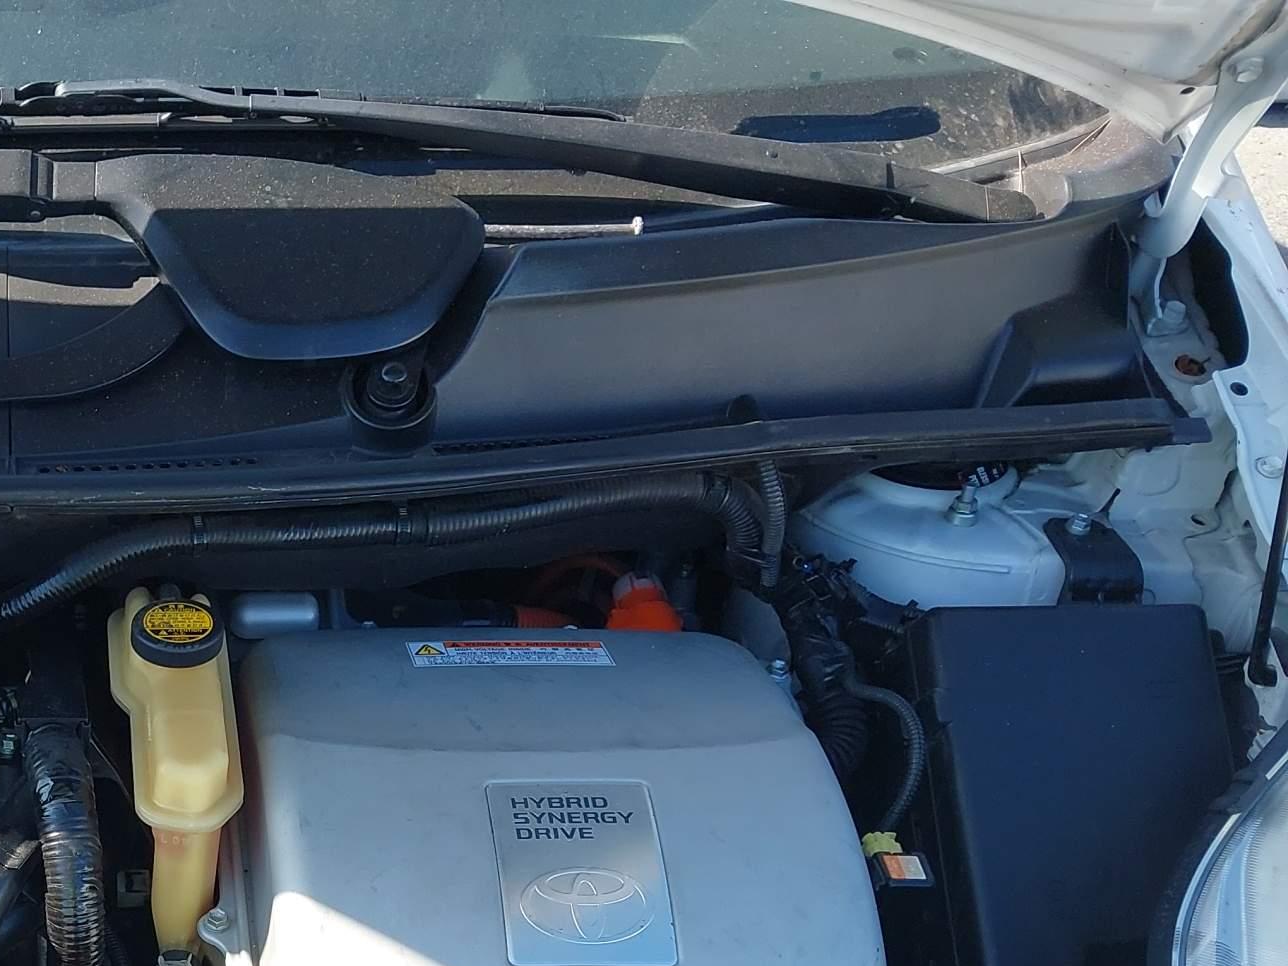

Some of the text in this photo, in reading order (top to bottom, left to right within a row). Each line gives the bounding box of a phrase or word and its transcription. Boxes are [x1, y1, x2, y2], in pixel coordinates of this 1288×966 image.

[510, 796, 609, 809] HYBRID
[513, 811, 634, 825] SYNERGY
[515, 827, 595, 840] DRIVE
